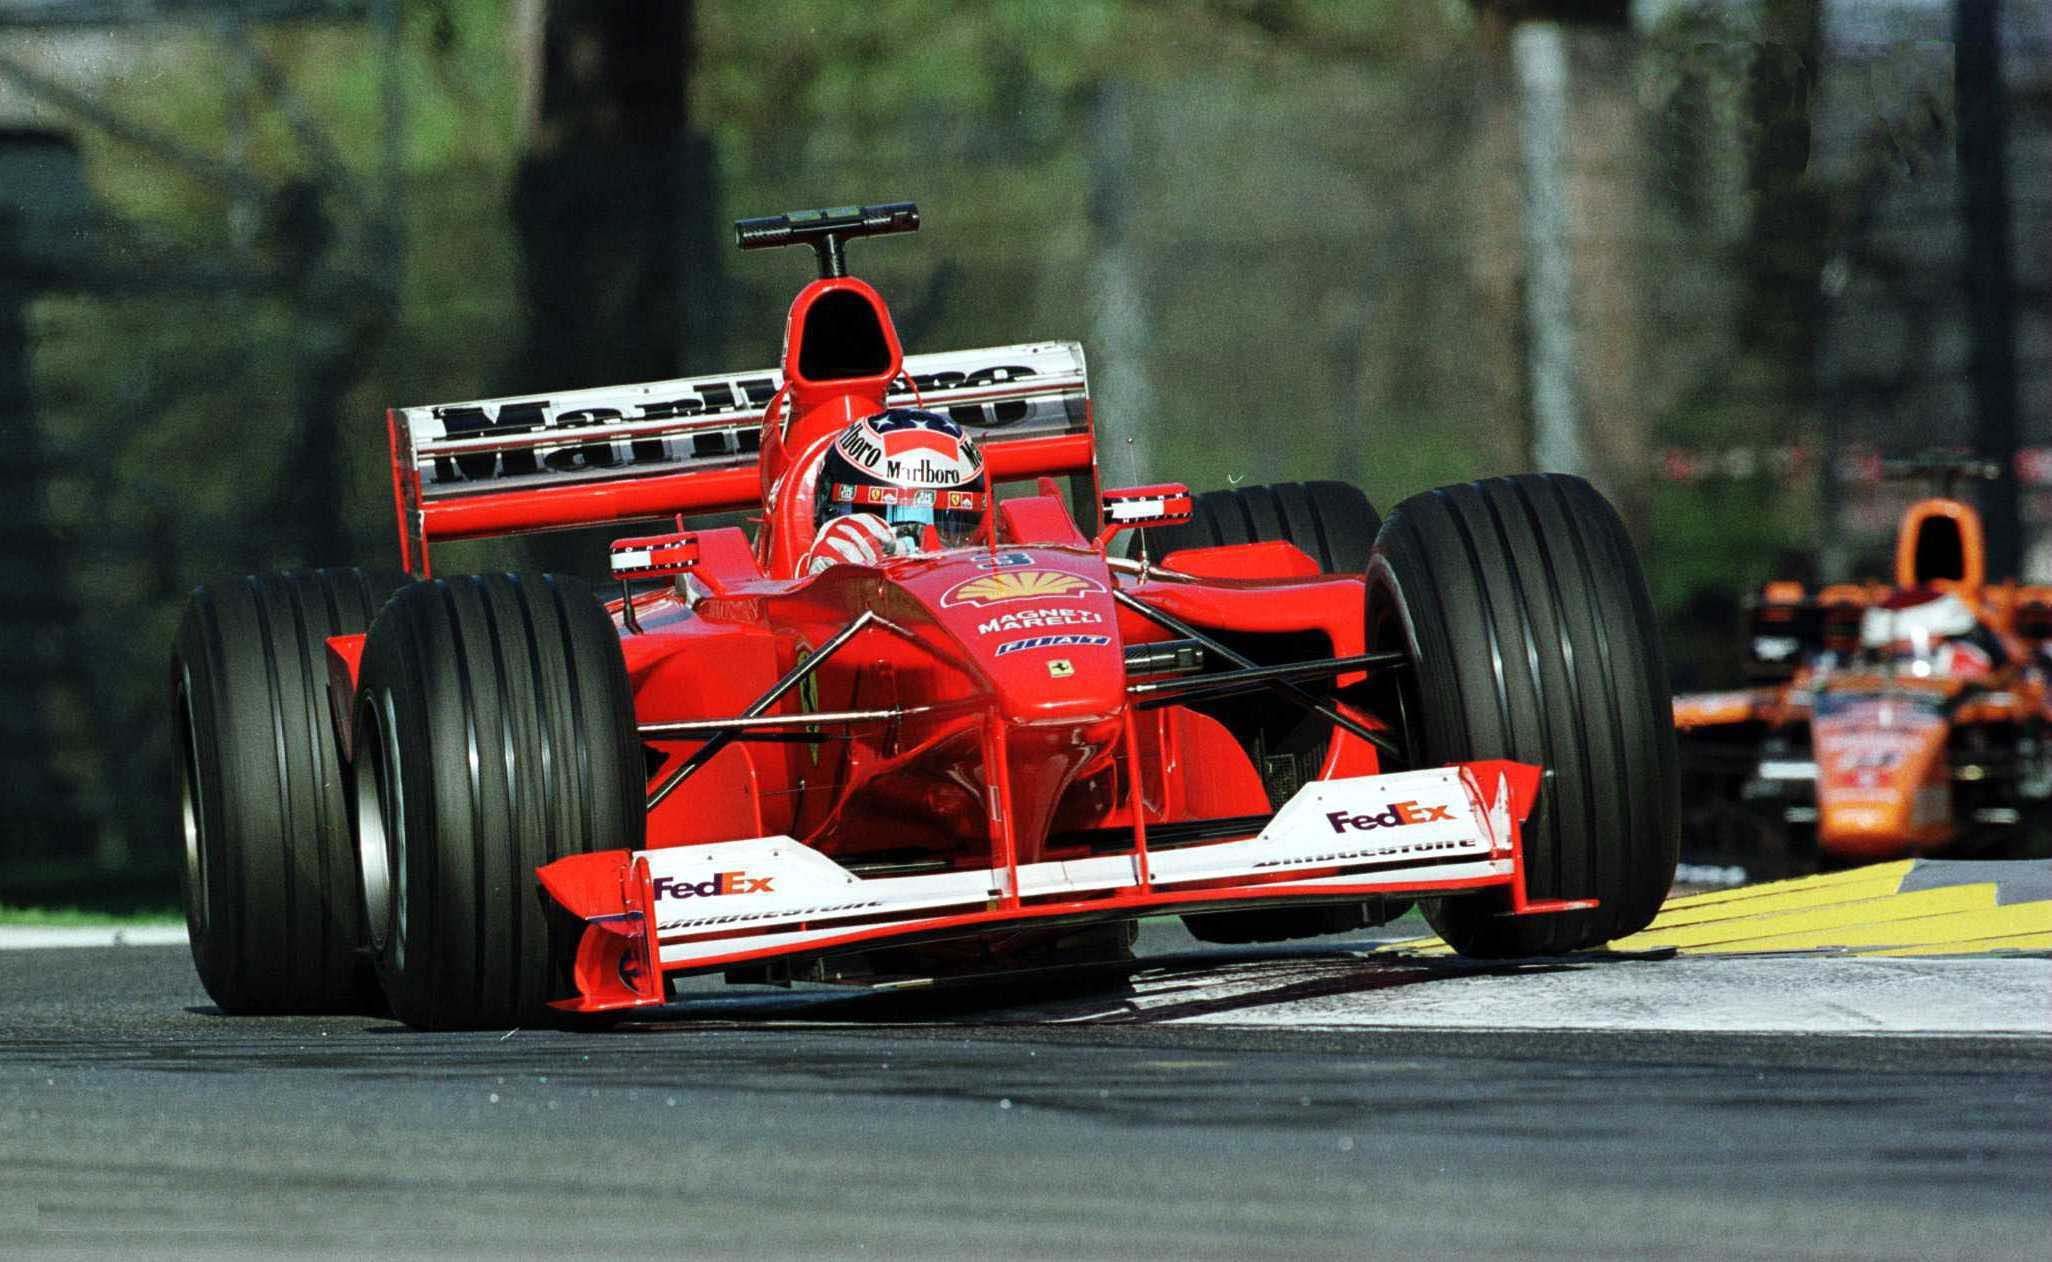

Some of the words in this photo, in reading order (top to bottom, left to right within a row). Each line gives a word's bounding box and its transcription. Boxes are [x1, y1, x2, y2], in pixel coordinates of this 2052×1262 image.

[839, 421, 882, 468] lboro
[886, 459, 961, 484] Marlboro
[978, 608, 1103, 630] MAGNETI
[978, 613, 1103, 635] MARELLI
[1326, 800, 1457, 834] FedEx
[653, 871, 775, 901] FedEx
